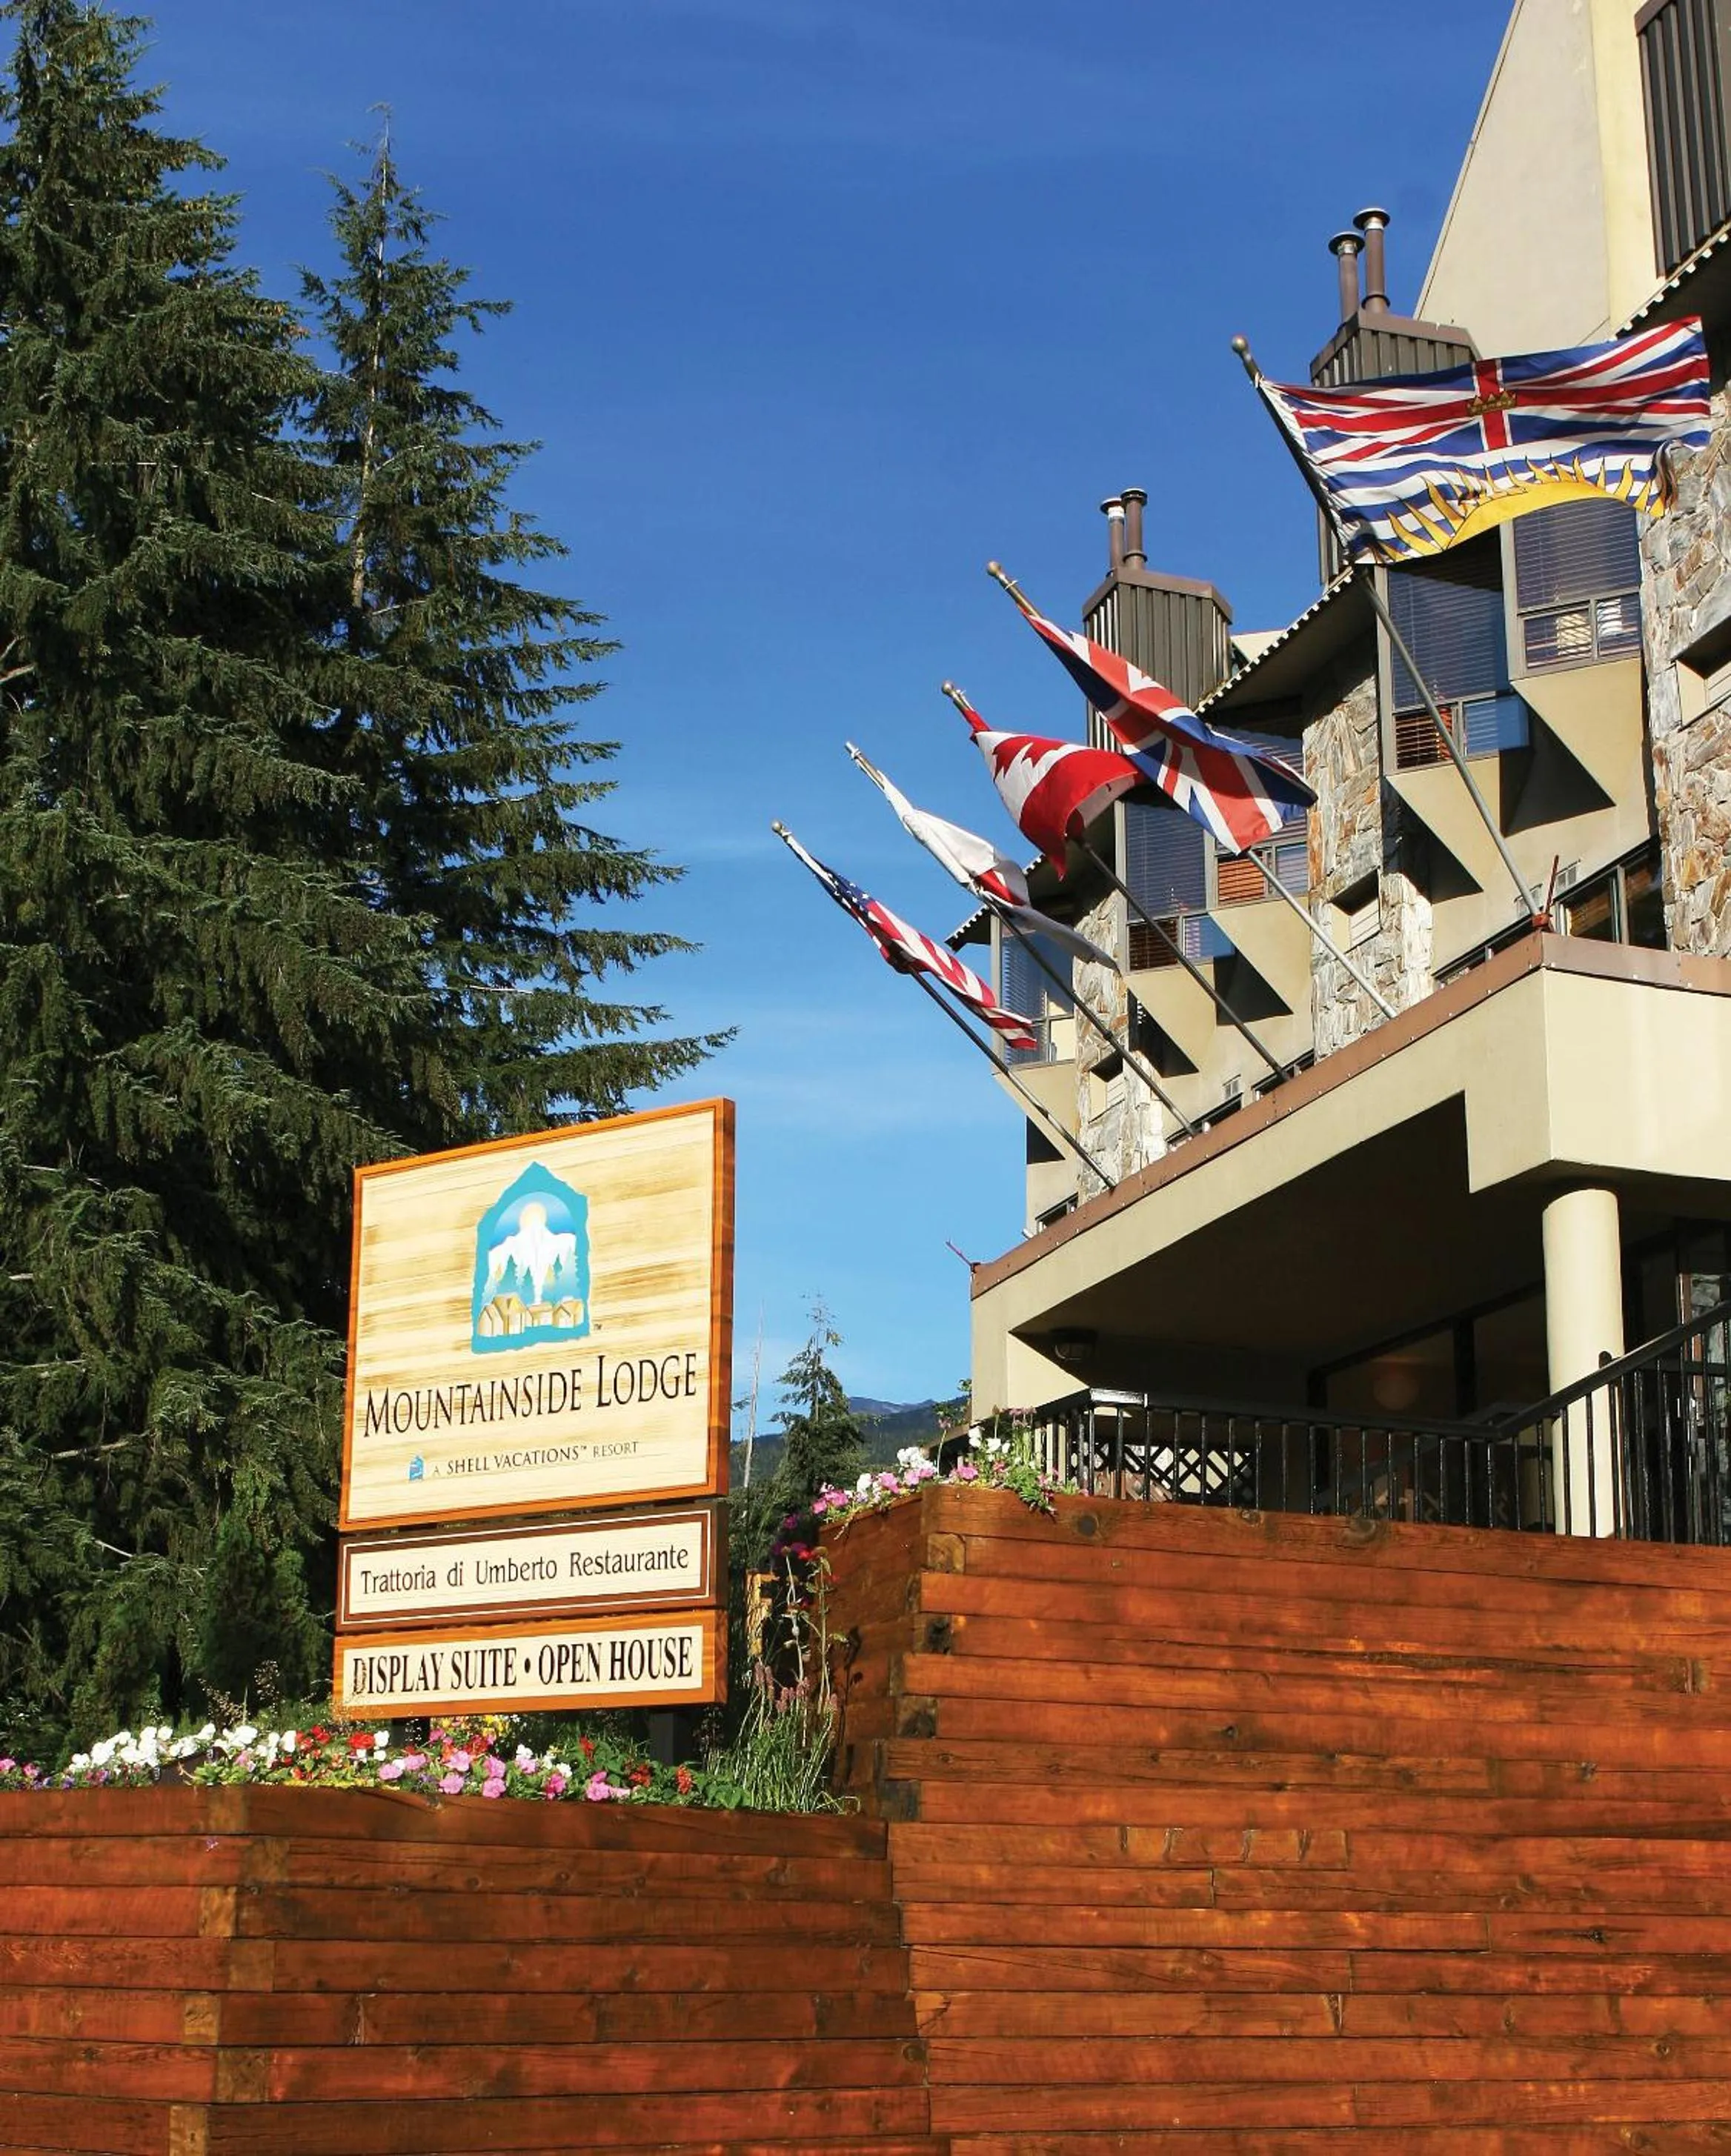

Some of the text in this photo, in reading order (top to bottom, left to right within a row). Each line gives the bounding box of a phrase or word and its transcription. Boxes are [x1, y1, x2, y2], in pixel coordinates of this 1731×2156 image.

[364, 1353, 697, 1437] MOUNTAINSIDE LODGE
[433, 1466, 440, 1477] A
[446, 1457, 490, 1475] SHELL
[593, 1441, 638, 1458] RESORT
[361, 1544, 688, 1595] Trattoria di Umberto Restaurante
[353, 1636, 693, 1697] DISPLAY SUITE OPEN HOUSE
